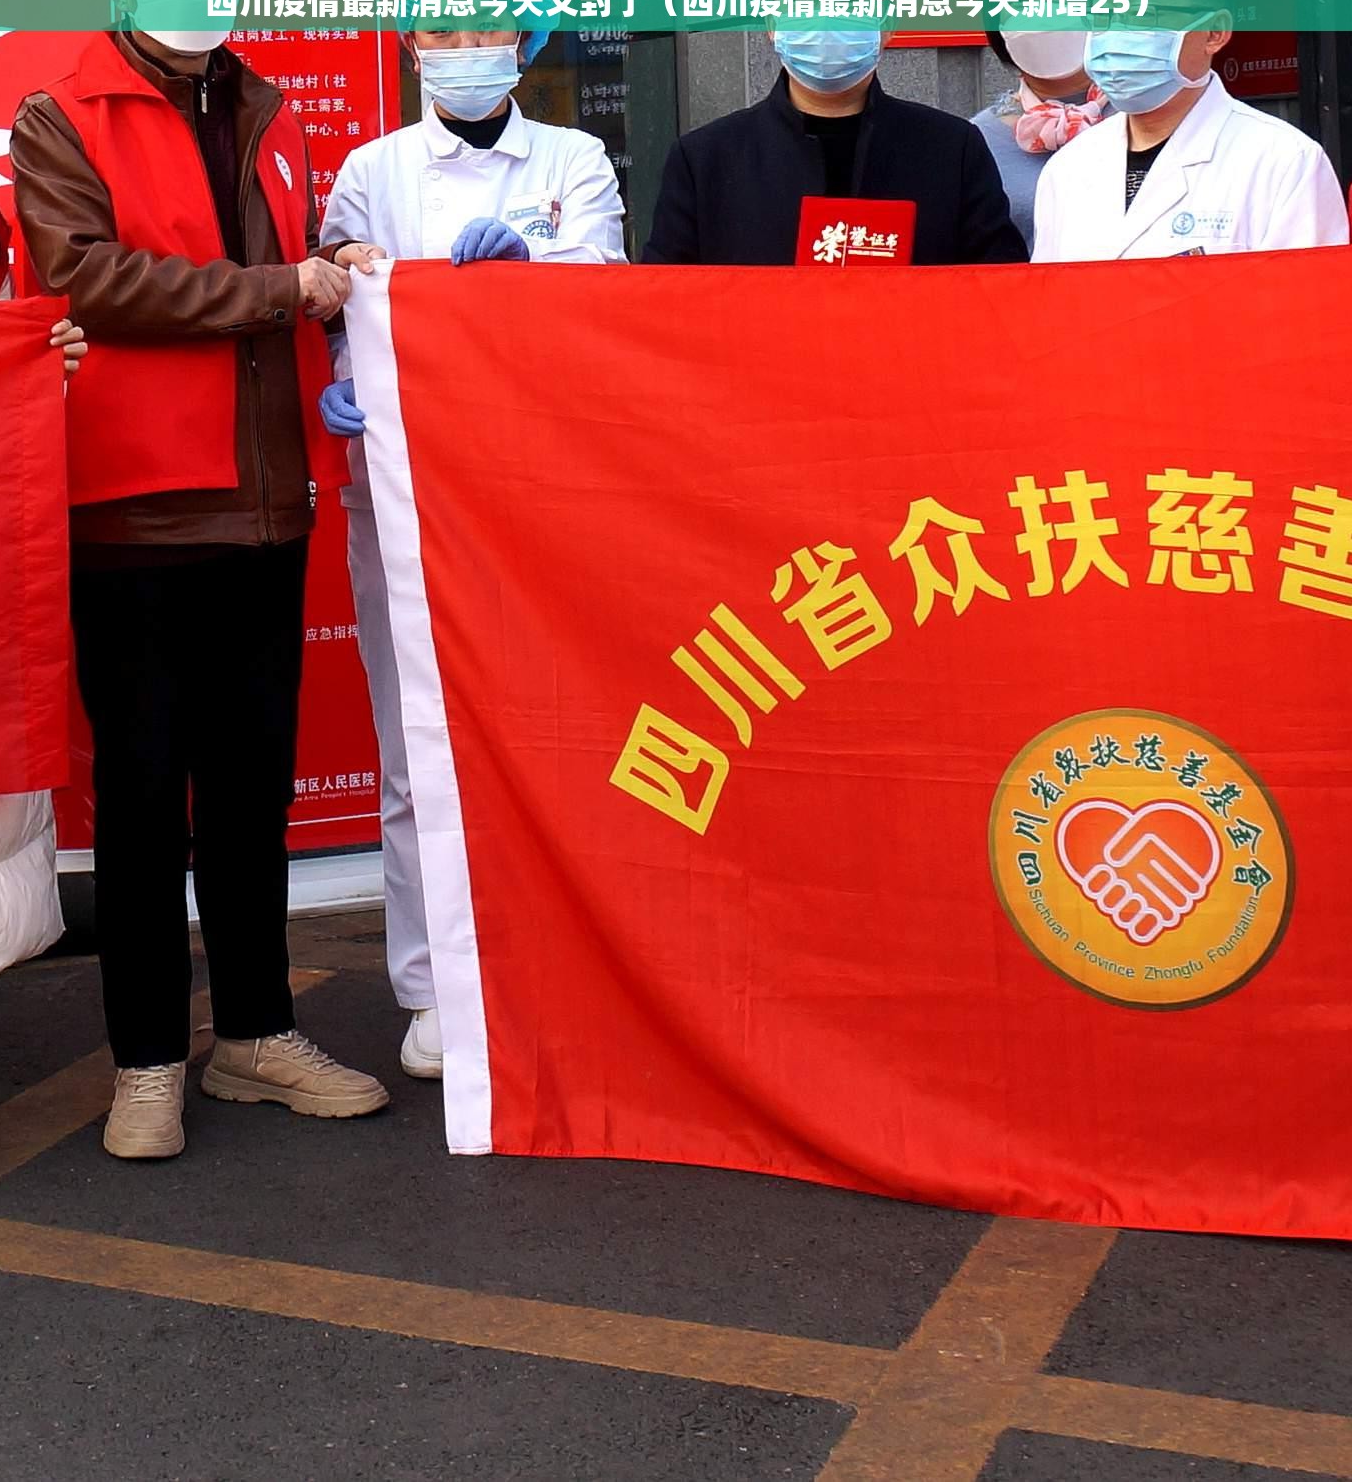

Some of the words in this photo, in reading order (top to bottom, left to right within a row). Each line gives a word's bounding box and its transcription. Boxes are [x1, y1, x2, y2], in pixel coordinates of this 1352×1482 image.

[812, 220, 899, 263] 荣誉证书
[294, 772, 376, 794] 新区人民医院
[1028, 888, 1071, 944] Sichuan
[1074, 940, 1136, 979] Province
[1143, 960, 1205, 981] Zhongfu
[1206, 894, 1260, 964] Foundation
